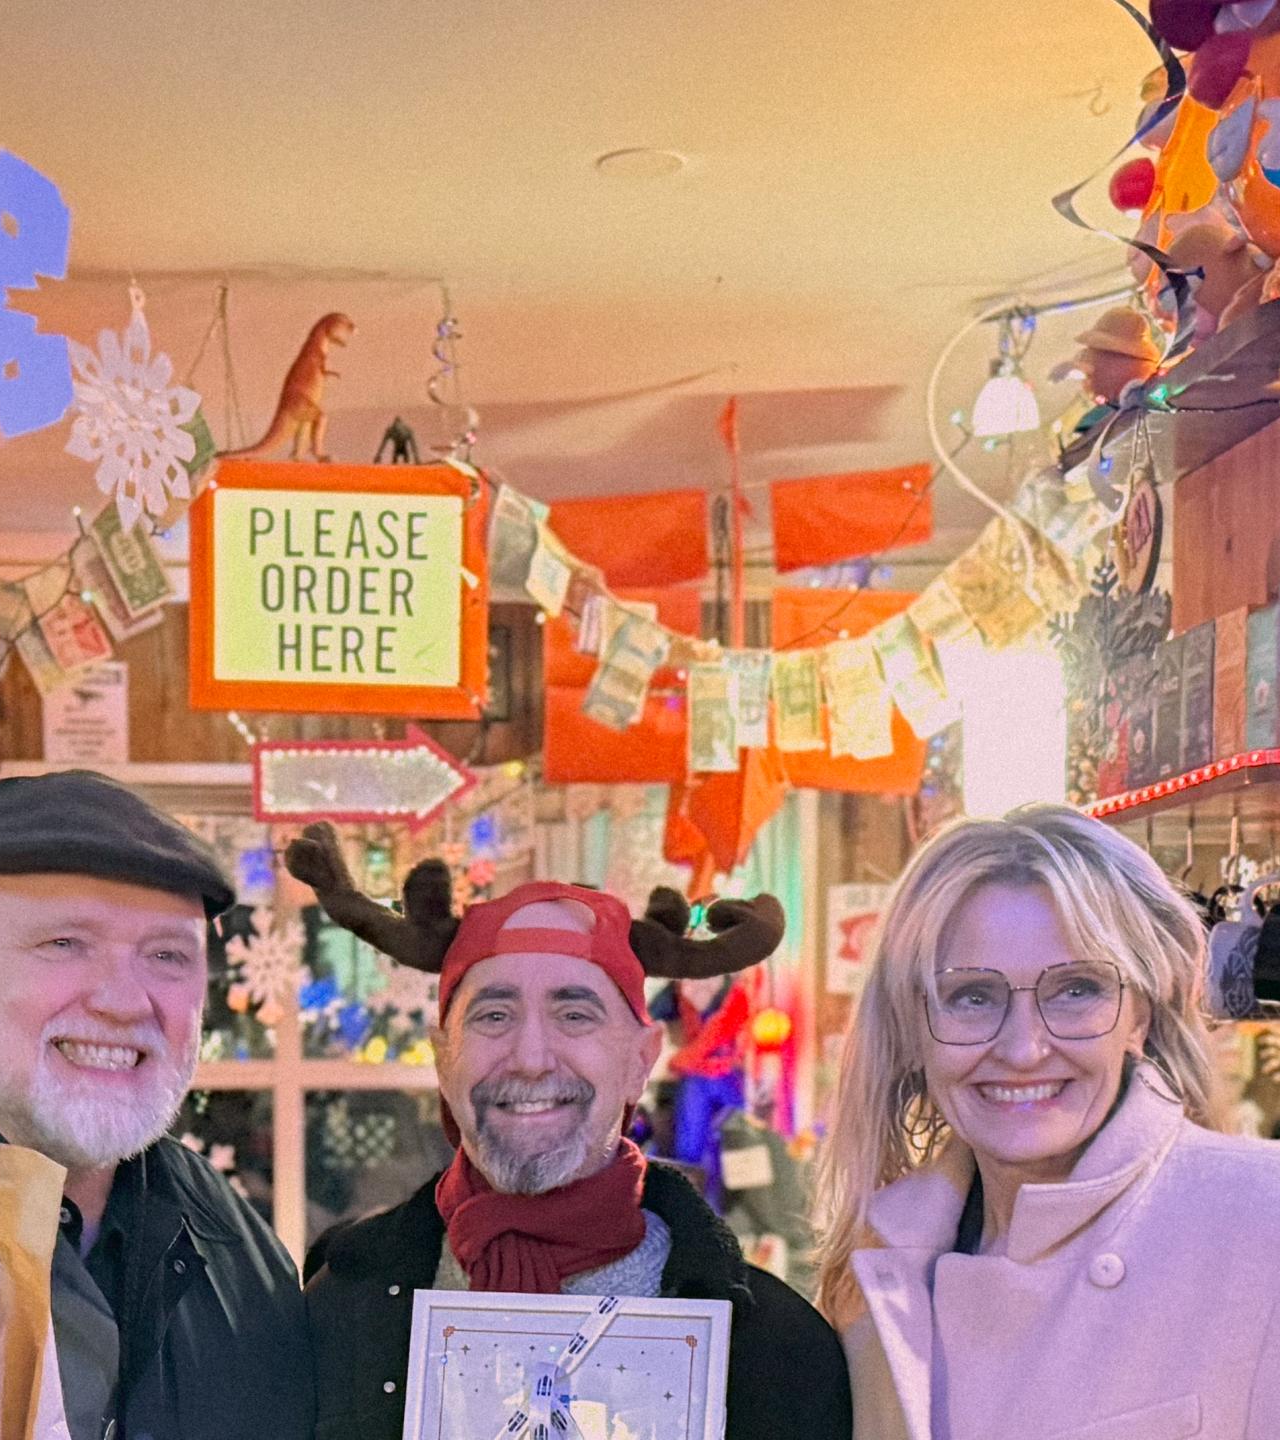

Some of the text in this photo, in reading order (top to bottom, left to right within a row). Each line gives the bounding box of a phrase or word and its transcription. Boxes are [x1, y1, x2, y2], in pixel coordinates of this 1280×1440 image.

[249, 507, 428, 560] PLEASE
[261, 563, 413, 617] ORDER
[278, 623, 397, 673] HERE
